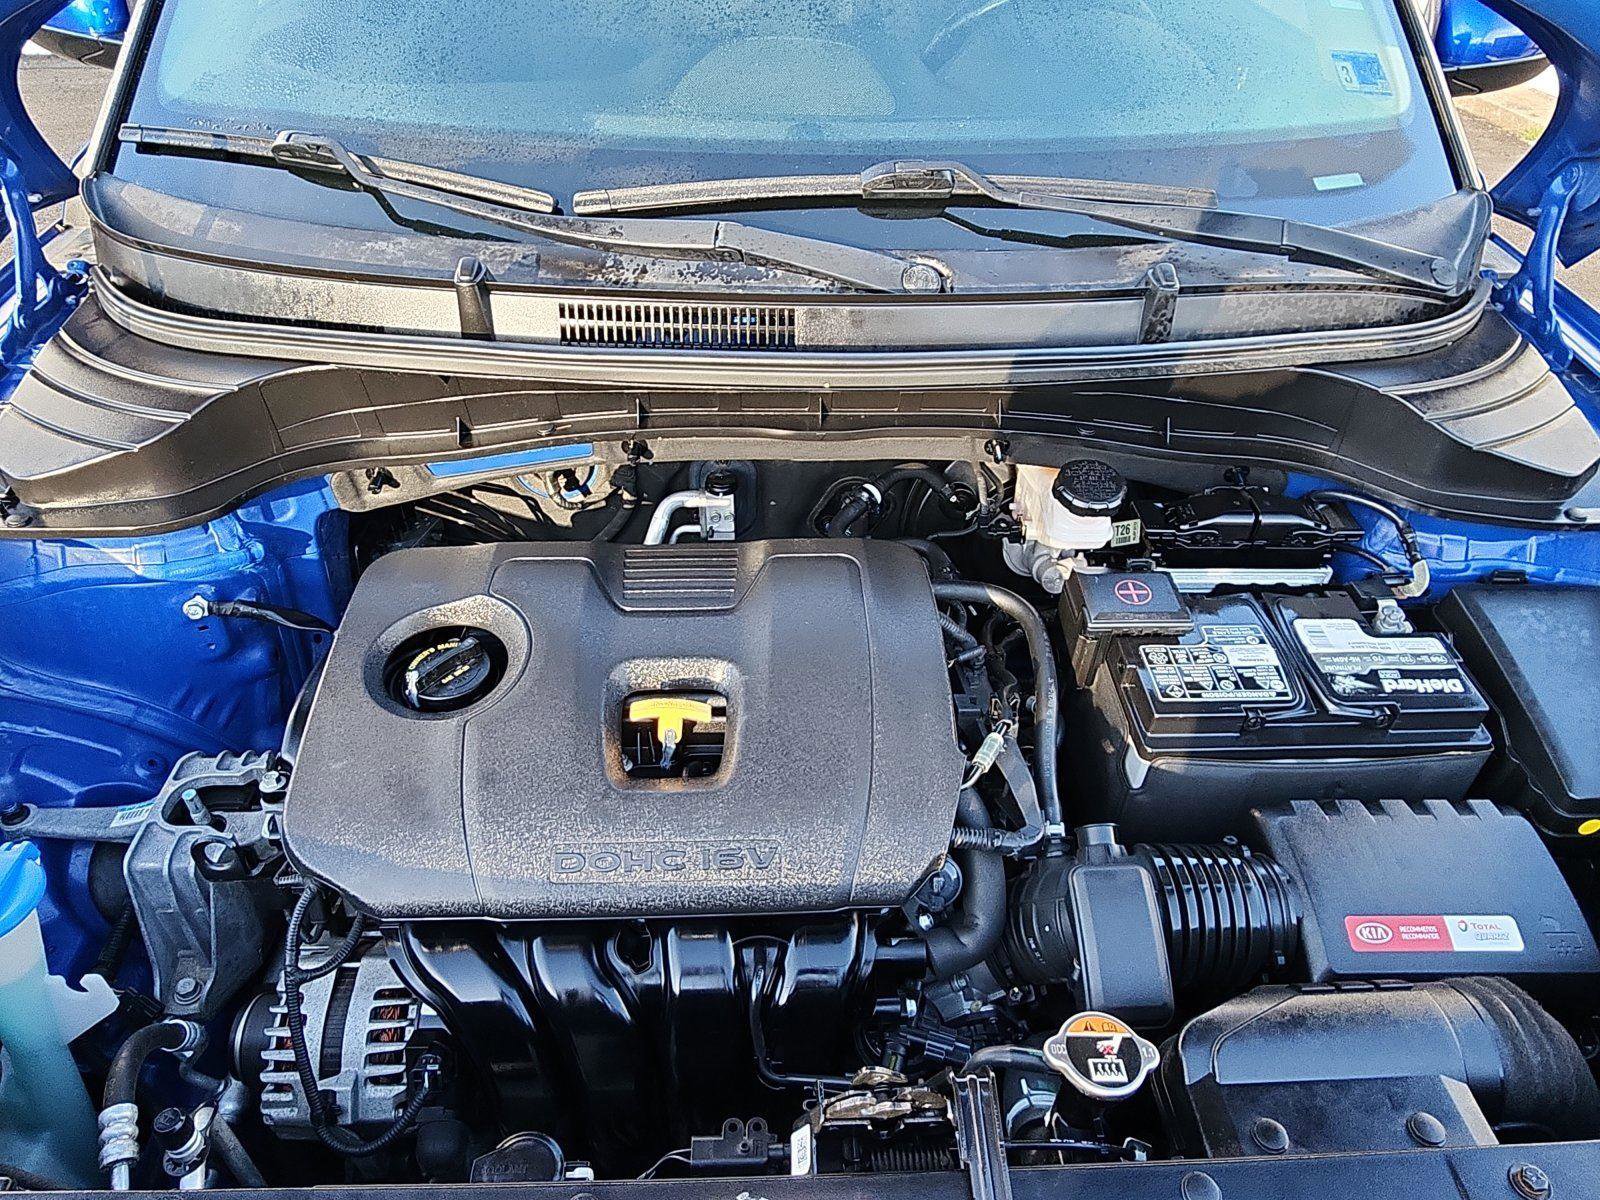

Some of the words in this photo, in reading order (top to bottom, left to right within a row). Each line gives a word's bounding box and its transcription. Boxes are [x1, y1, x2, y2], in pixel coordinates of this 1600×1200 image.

[1115, 524, 1131, 537] T26
[1381, 678, 1465, 693] DieHard
[554, 849, 687, 874] DOHC
[701, 847, 778, 871] 16V
[1469, 922, 1503, 931] TOTAL
